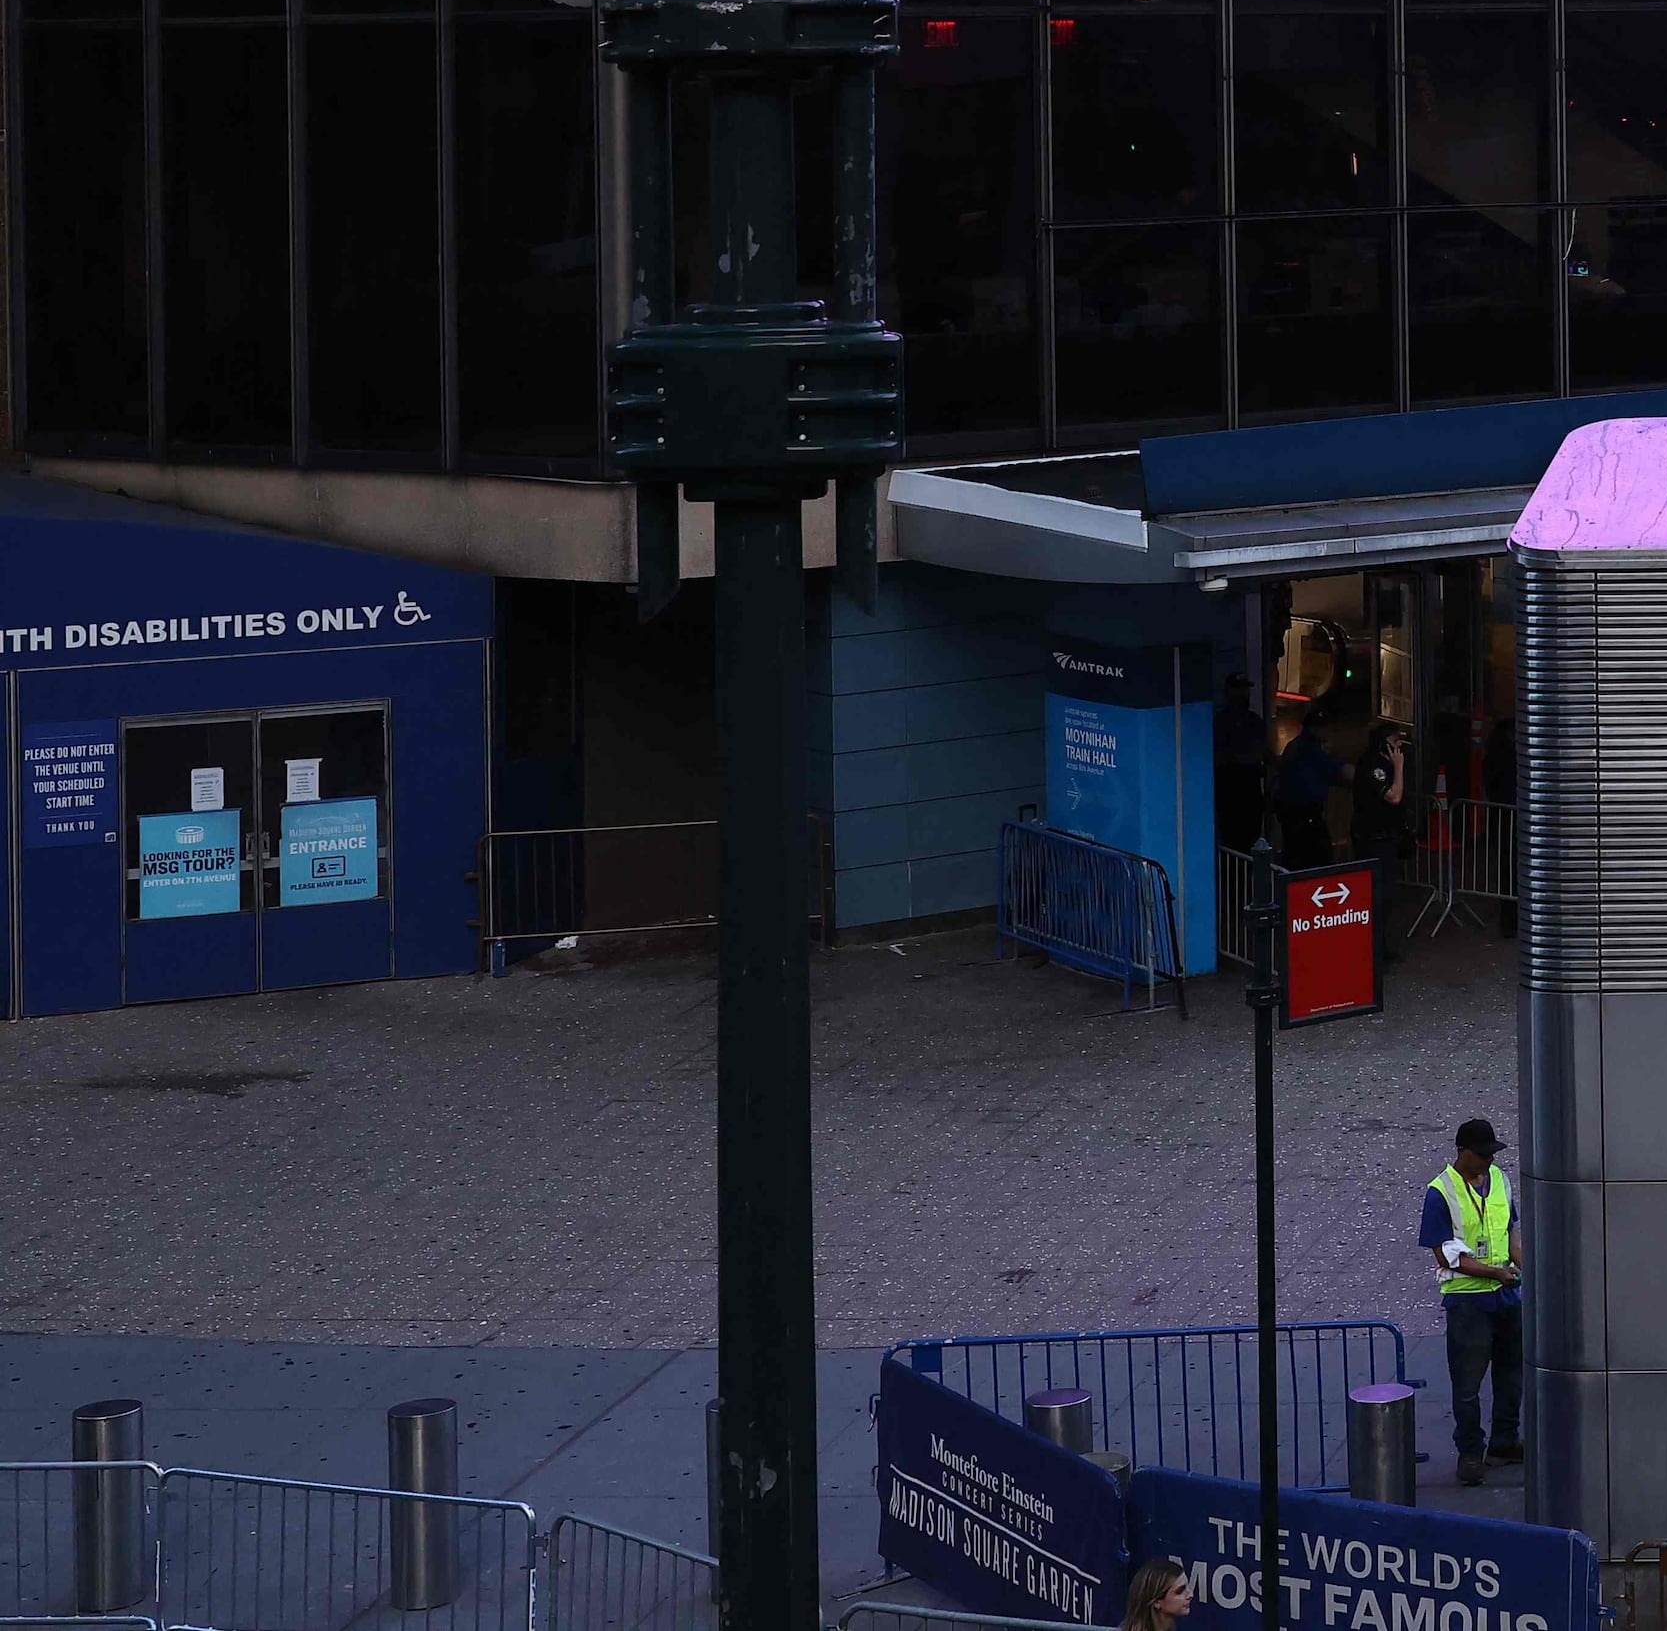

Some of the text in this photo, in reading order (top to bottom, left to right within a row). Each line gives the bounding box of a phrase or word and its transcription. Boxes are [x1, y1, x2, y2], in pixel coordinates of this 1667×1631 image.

[64, 612, 286, 649] DISABILITIES
[296, 605, 385, 635] ONLY
[1069, 659, 1125, 678] AMTRAK
[1065, 727, 1117, 751] MOYNIHAN
[24, 742, 115, 762] PLEASE DO NOT ENTER
[1065, 744, 1117, 768] TRAIN HALL
[35, 760, 105, 776] THE VENUE UNTIL
[33, 777, 105, 793] YOUR SCHEDULED
[46, 794, 95, 810] START TIME
[46, 820, 95, 835] THANK YOU
[143, 847, 235, 863] LOOKING FOR THE
[289, 837, 368, 855] ENTRANCE
[143, 856, 235, 877] MSG TOUR?
[143, 873, 237, 888] ENTER ON 7TH AVENUE
[290, 881, 315, 891] PLEASE
[317, 880, 334, 889] HAVE
[344, 877, 368, 887] READY.
[1292, 908, 1370, 934] No Standing
[929, 1432, 1056, 1525] Montefiore Einstein
[940, 1470, 1044, 1543] CONCERT SERIES
[888, 1478, 1094, 1627] MADISON SQUARE GARDEN
[1300, 1532, 1501, 1600] WORLD'S
